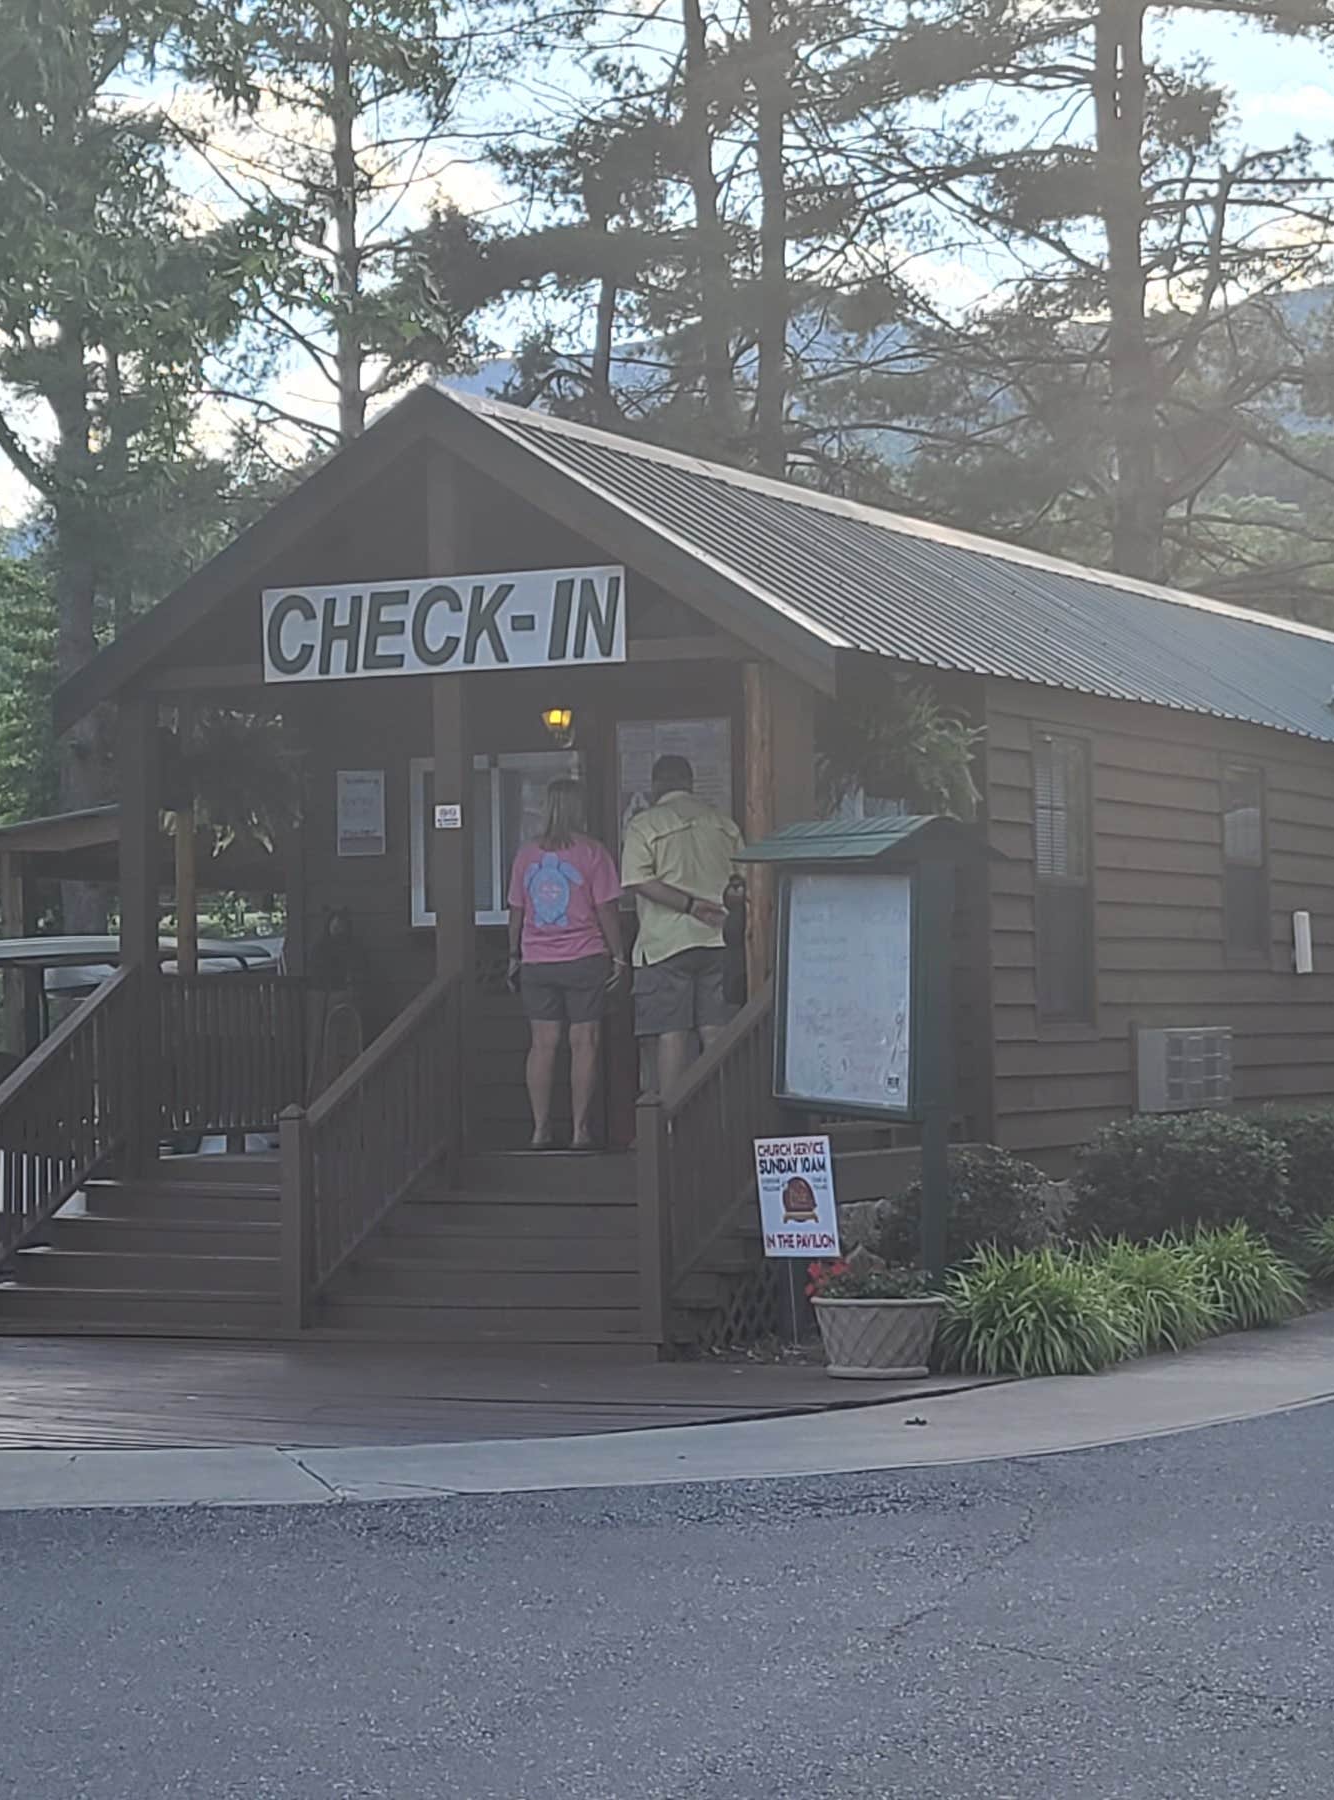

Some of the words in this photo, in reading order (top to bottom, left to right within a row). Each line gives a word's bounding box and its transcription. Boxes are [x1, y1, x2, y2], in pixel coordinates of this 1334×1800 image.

[267, 576, 621, 675] CHECK-IN
[757, 1144, 791, 1157] CHURCH
[794, 1142, 825, 1156] SERVICE
[759, 1158, 798, 1175] SUNDAY
[766, 1234, 775, 1249] IN
[777, 1234, 795, 1249] THE
[796, 1233, 836, 1249] PAVILION
